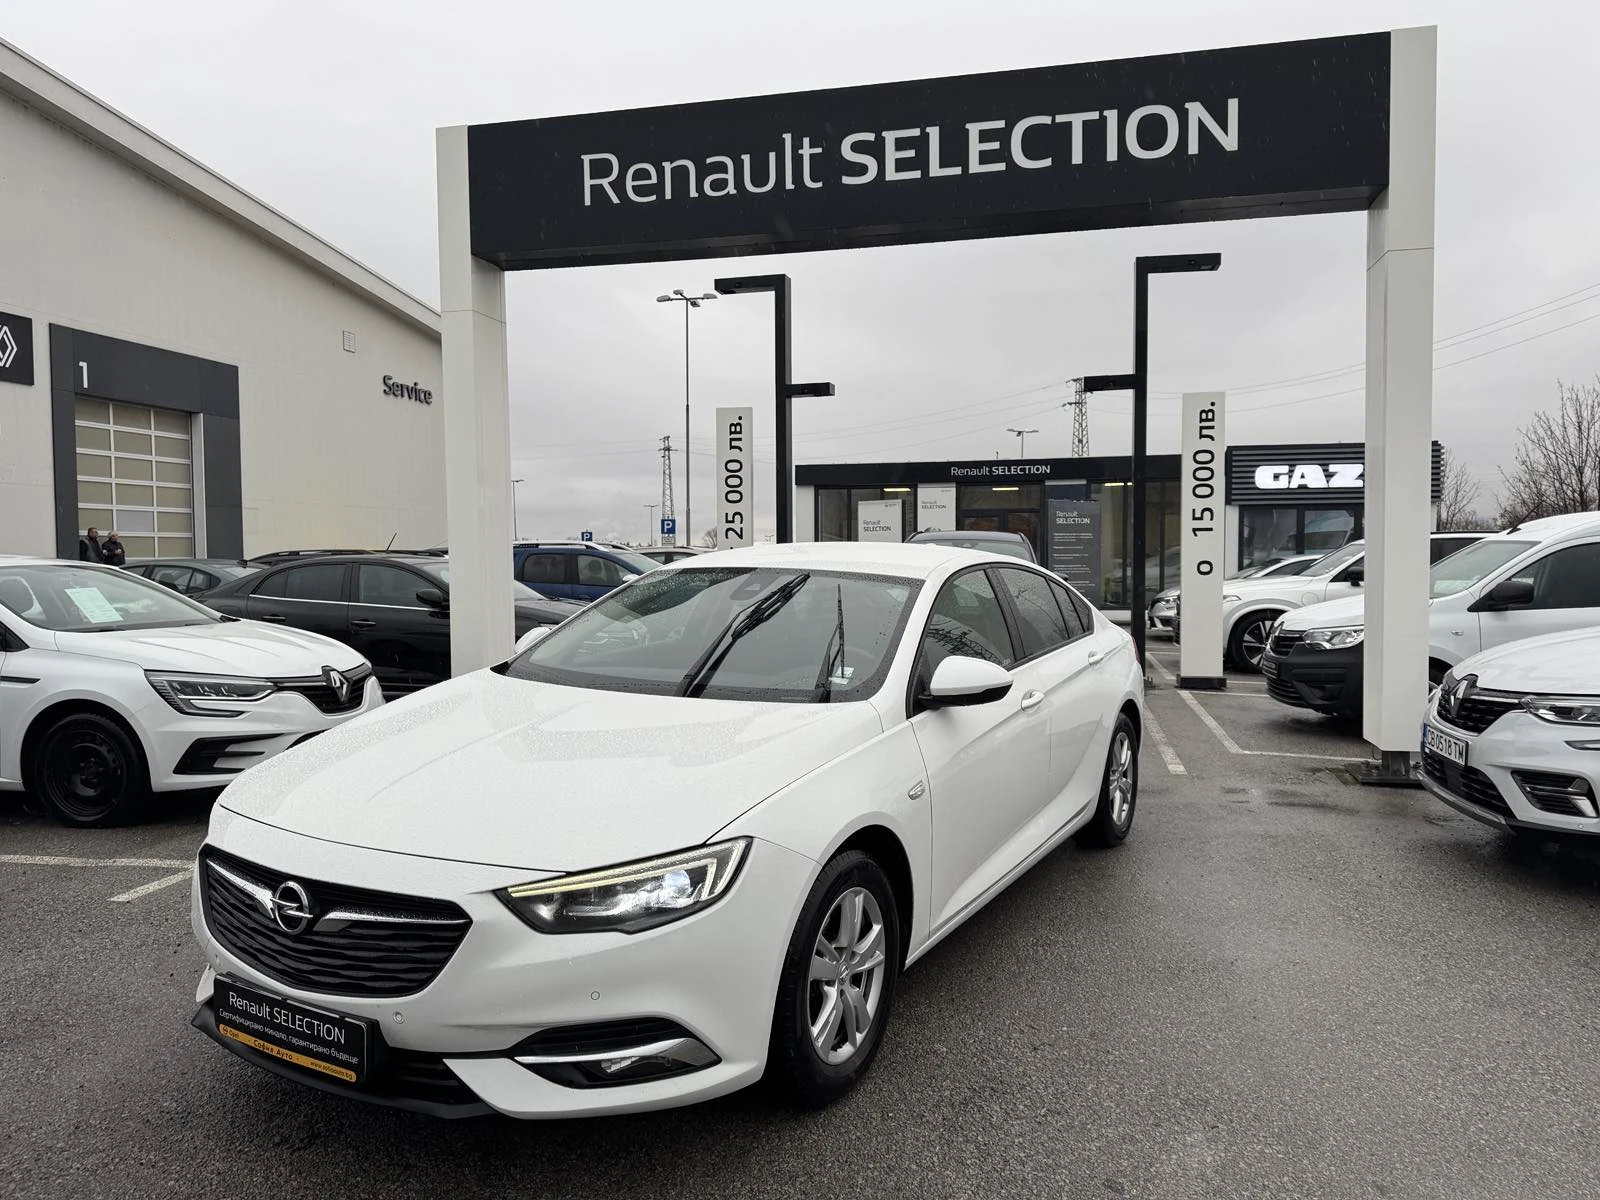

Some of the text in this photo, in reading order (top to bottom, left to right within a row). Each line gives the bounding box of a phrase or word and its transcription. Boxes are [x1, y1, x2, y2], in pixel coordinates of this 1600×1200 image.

[580, 97, 1239, 207] Renault SELECTION
[78, 360, 89, 389] 1
[382, 373, 433, 406] Service
[1198, 401, 1216, 442] лв.
[724, 415, 744, 540] 25 000 лв.
[950, 464, 1051, 476] Renault SELECTION
[1192, 449, 1215, 499] 000
[1254, 463, 1364, 490] GAZ
[664, 520, 673, 532] P
[1192, 507, 1215, 537] 15
[1435, 734, 1453, 756] 0518
[229, 991, 345, 1045] Renault SELECTION
[253, 1039, 293, 1061] София Ауто
[288, 1036, 330, 1054] гарантирано
[330, 1047, 359, 1065] бъдеще
